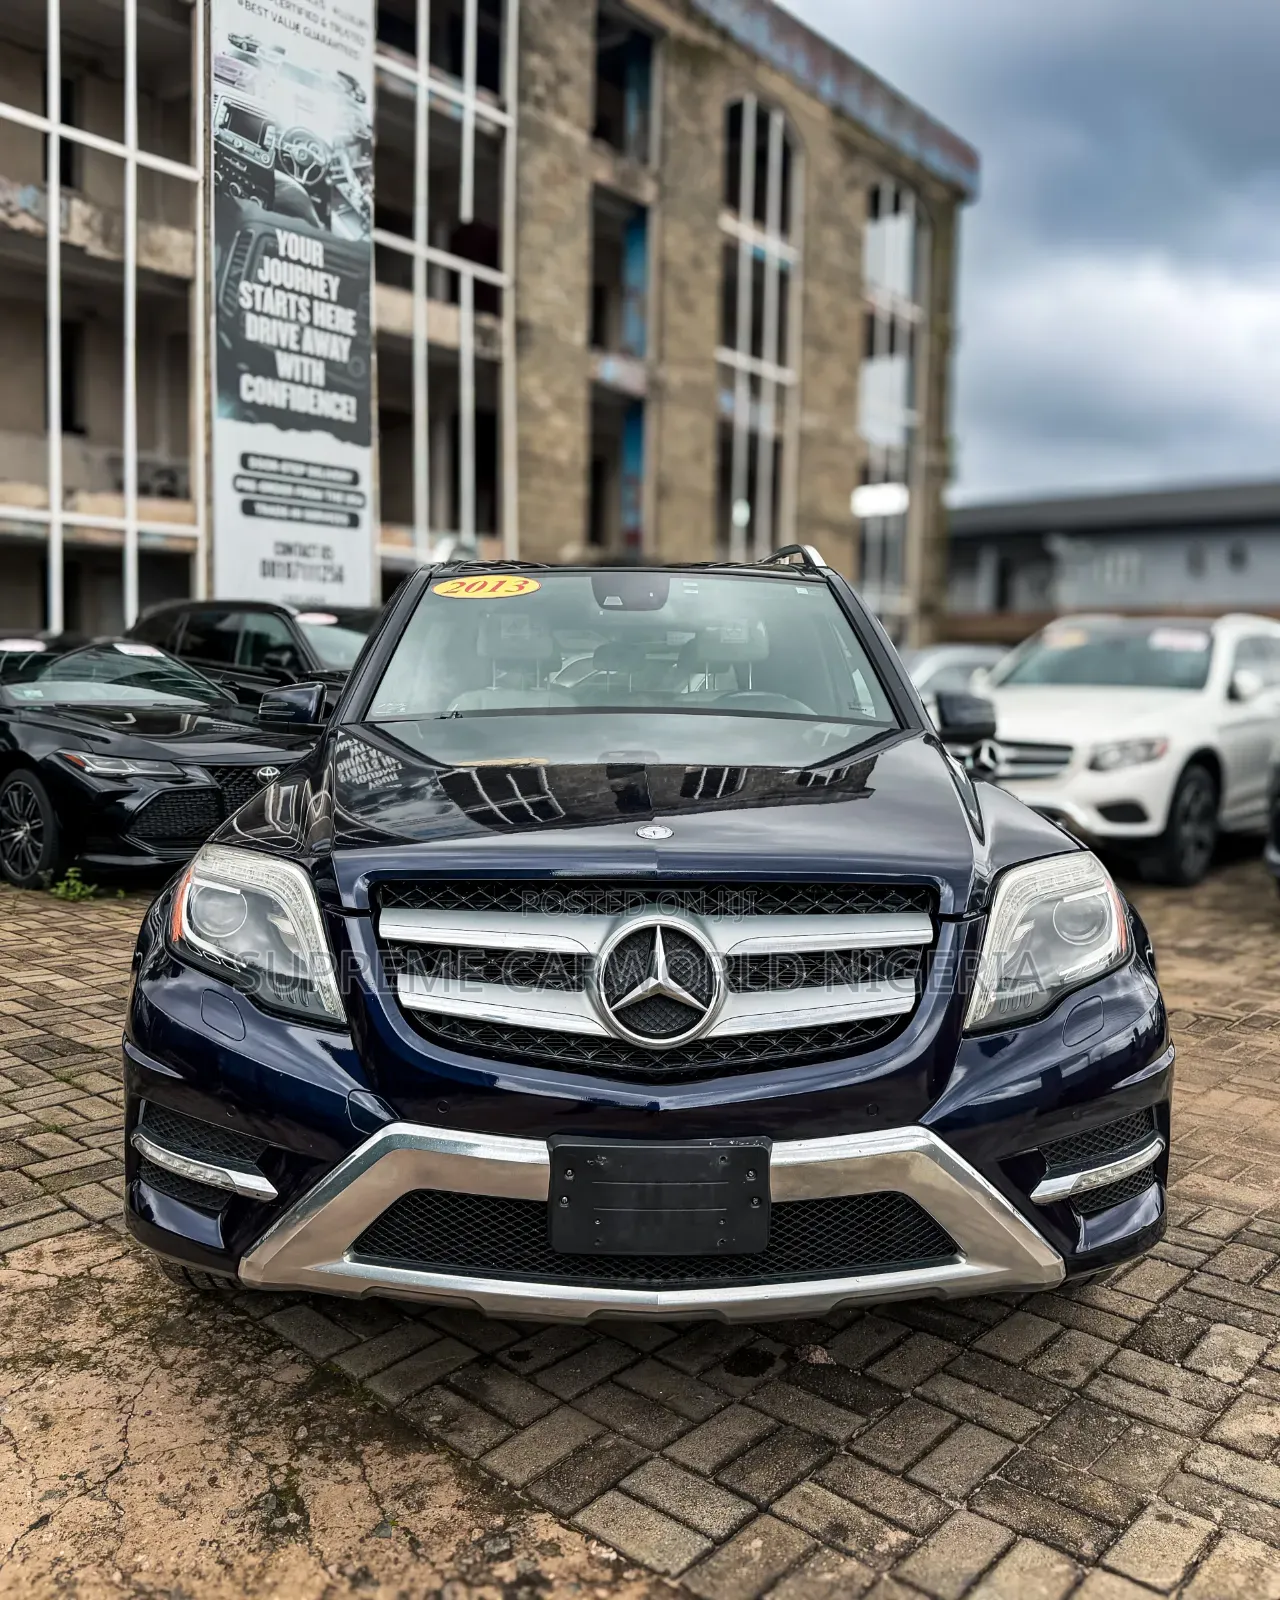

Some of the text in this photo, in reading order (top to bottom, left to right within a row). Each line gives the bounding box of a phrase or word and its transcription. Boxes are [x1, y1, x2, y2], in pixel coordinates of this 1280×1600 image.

[245, 0, 268, 18] BEST
[271, 11, 301, 35] VALUE
[276, 228, 324, 268] YOUR
[257, 255, 340, 302] JOURNEY
[238, 280, 357, 337] STARTS HERE
[244, 313, 352, 364] DRIVE AWAY
[274, 351, 325, 388] WITH
[239, 373, 357, 423] CONFIDENCE!
[443, 580, 530, 593] 2013
